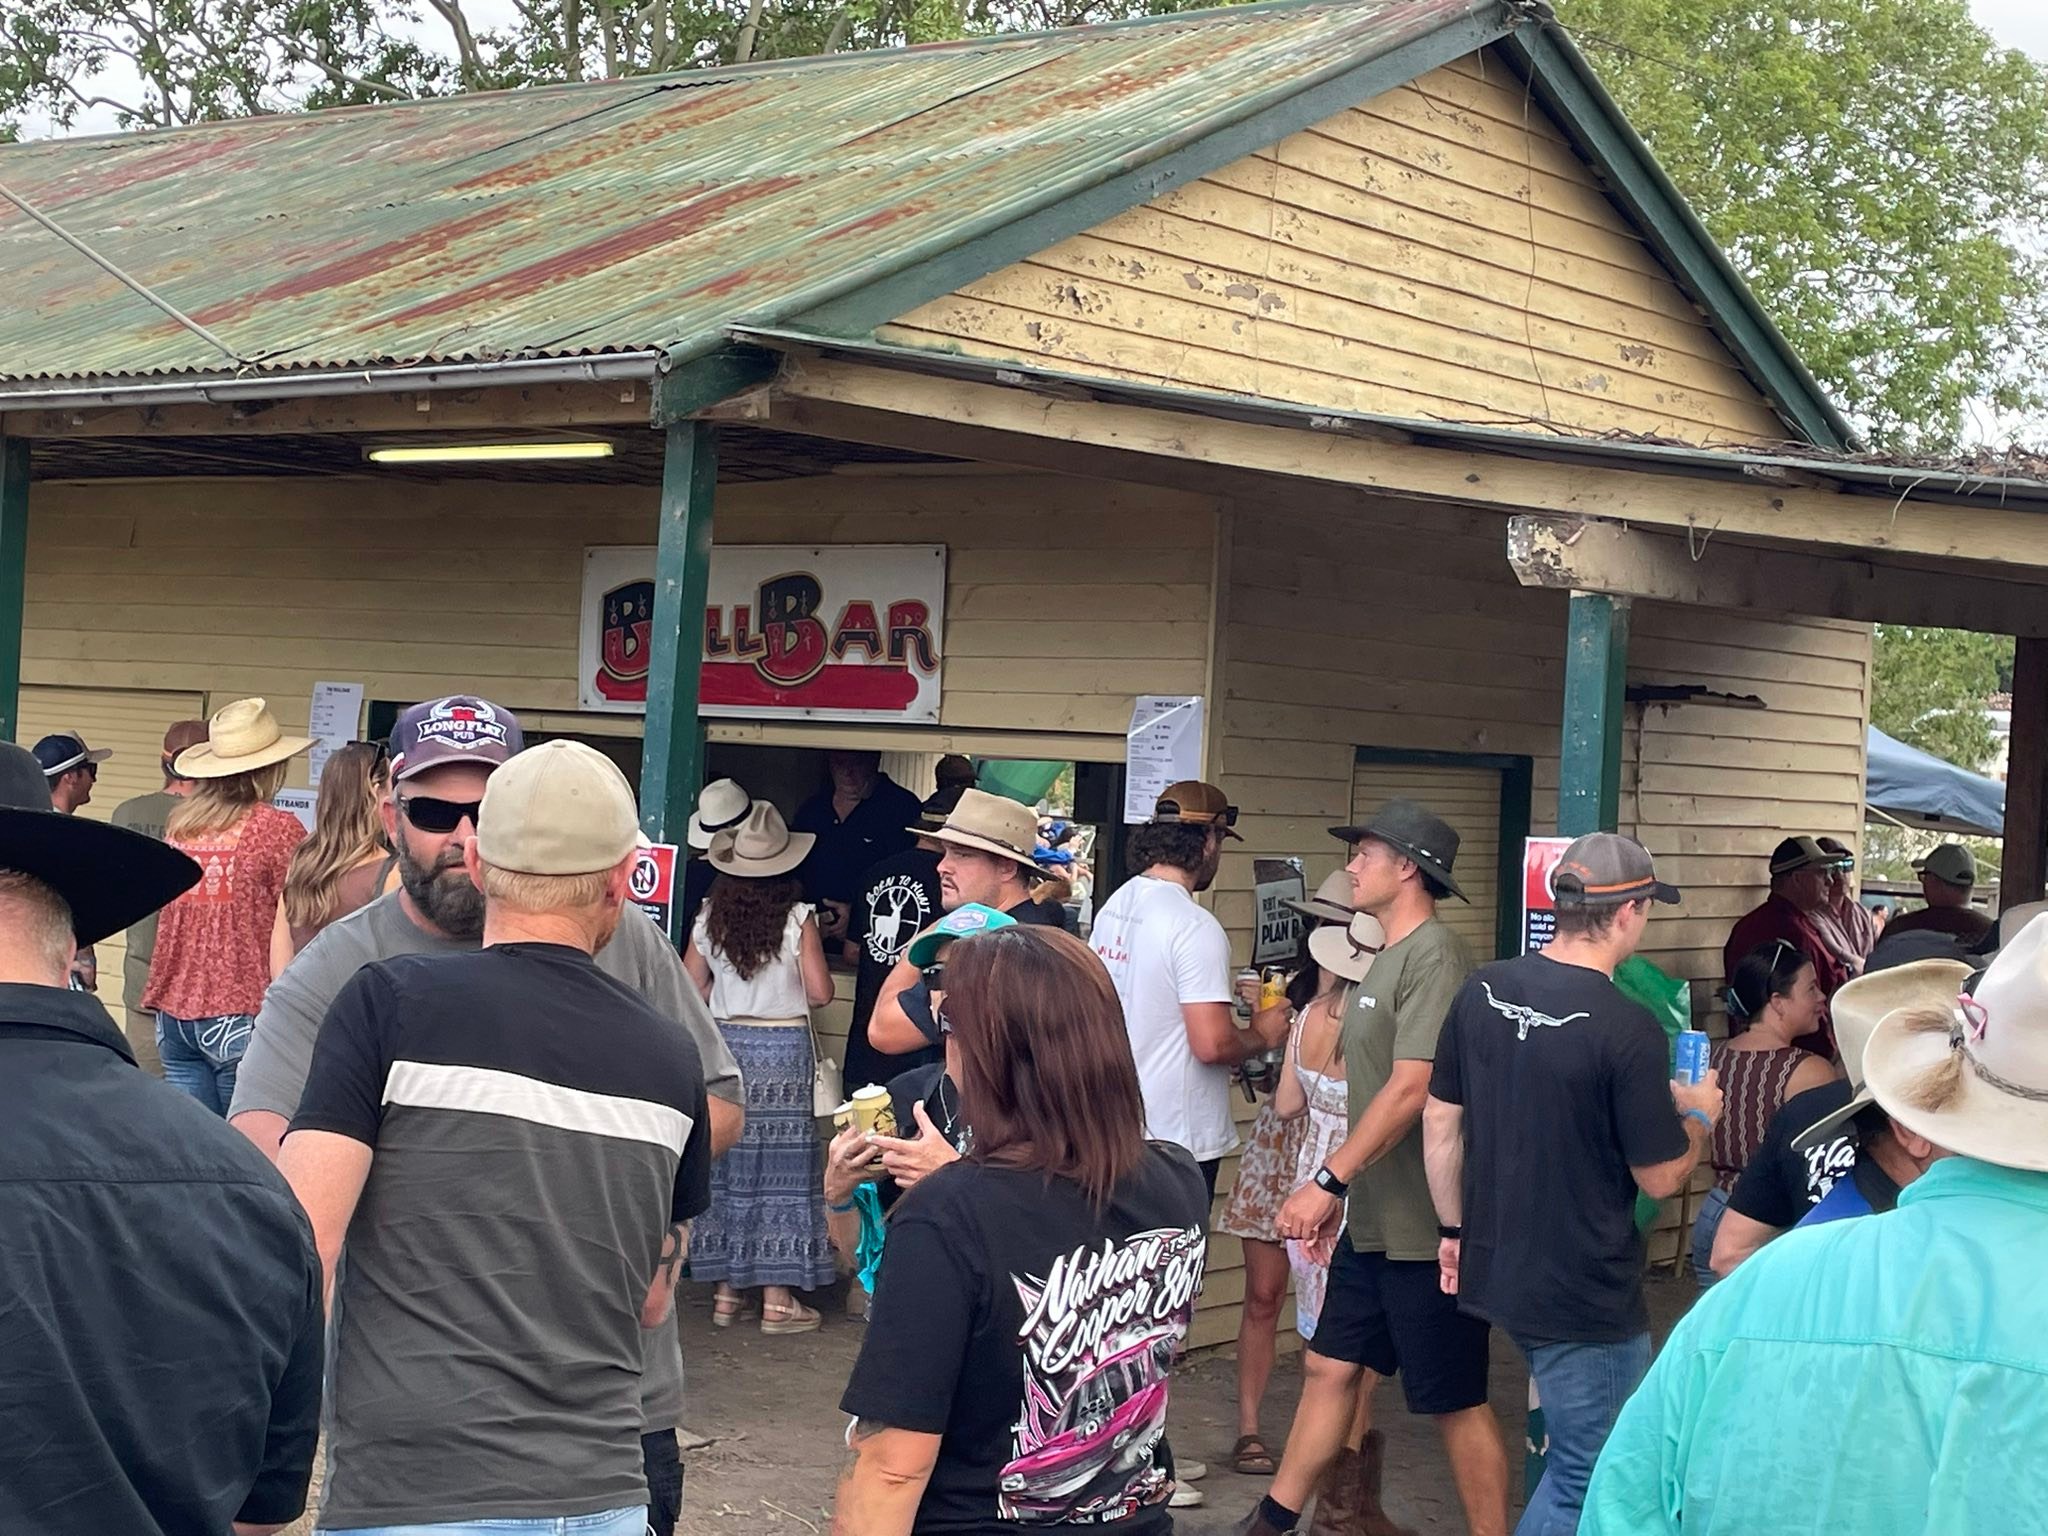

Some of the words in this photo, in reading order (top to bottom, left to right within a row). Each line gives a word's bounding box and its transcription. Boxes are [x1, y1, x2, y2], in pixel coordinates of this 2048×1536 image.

[602, 577, 767, 681] BLL
[757, 571, 940, 686] BAR
[424, 720, 465, 735] LONG
[453, 730, 475, 739] PUB
[275, 798, 309, 809] STBANDS
[866, 876, 896, 905] BORN
[899, 875, 912, 886] TO
[910, 881, 931, 914] HUNT
[1530, 912, 1542, 921] No
[1262, 919, 1289, 945] PLAN
[1018, 1236, 1164, 1337] Nathan
[1041, 1277, 1153, 1374] Cooper
